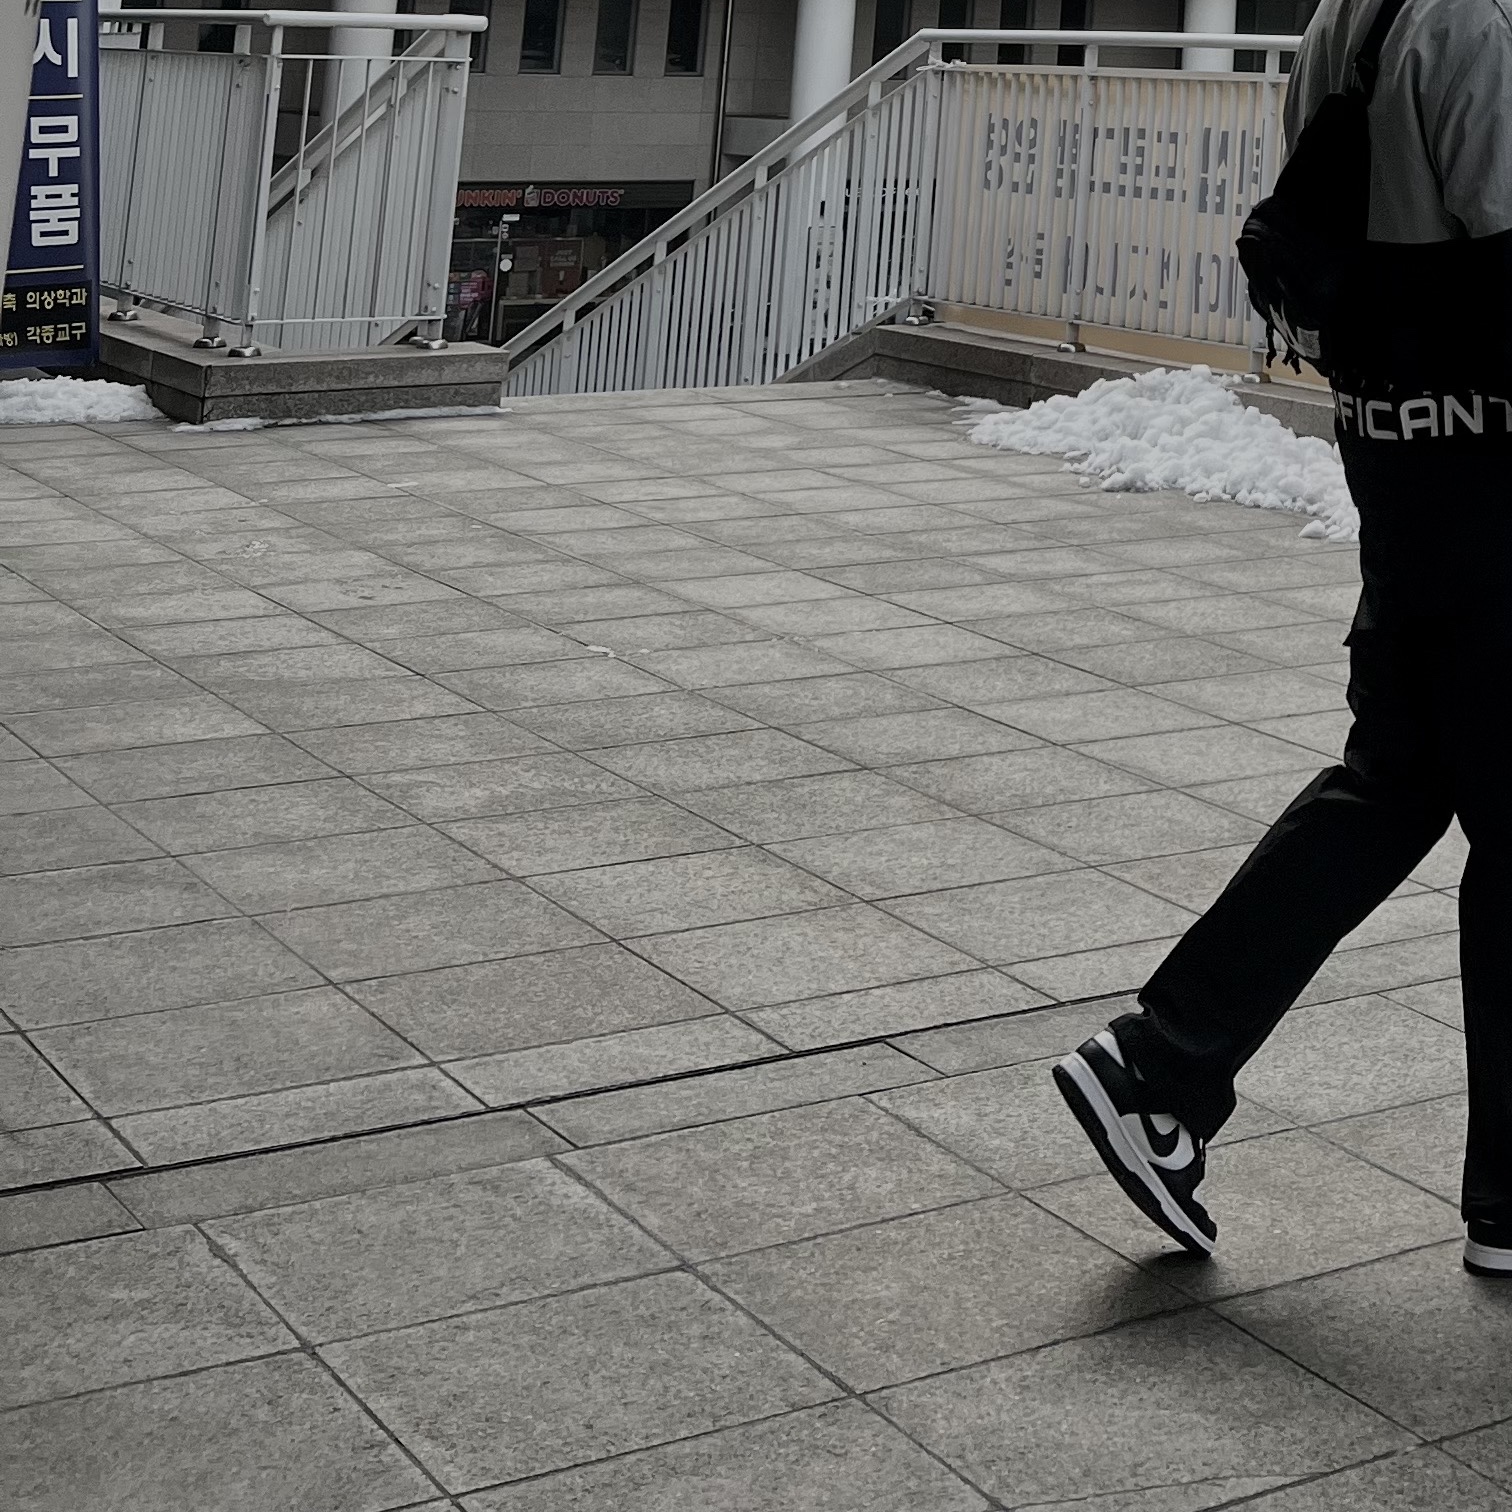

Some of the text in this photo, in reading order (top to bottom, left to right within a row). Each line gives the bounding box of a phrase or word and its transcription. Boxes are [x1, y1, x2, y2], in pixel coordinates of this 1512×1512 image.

[540, 189, 621, 206] DONUTS
[26, 287, 88, 310] 의상학과
[26, 321, 86, 345] 각종교구
